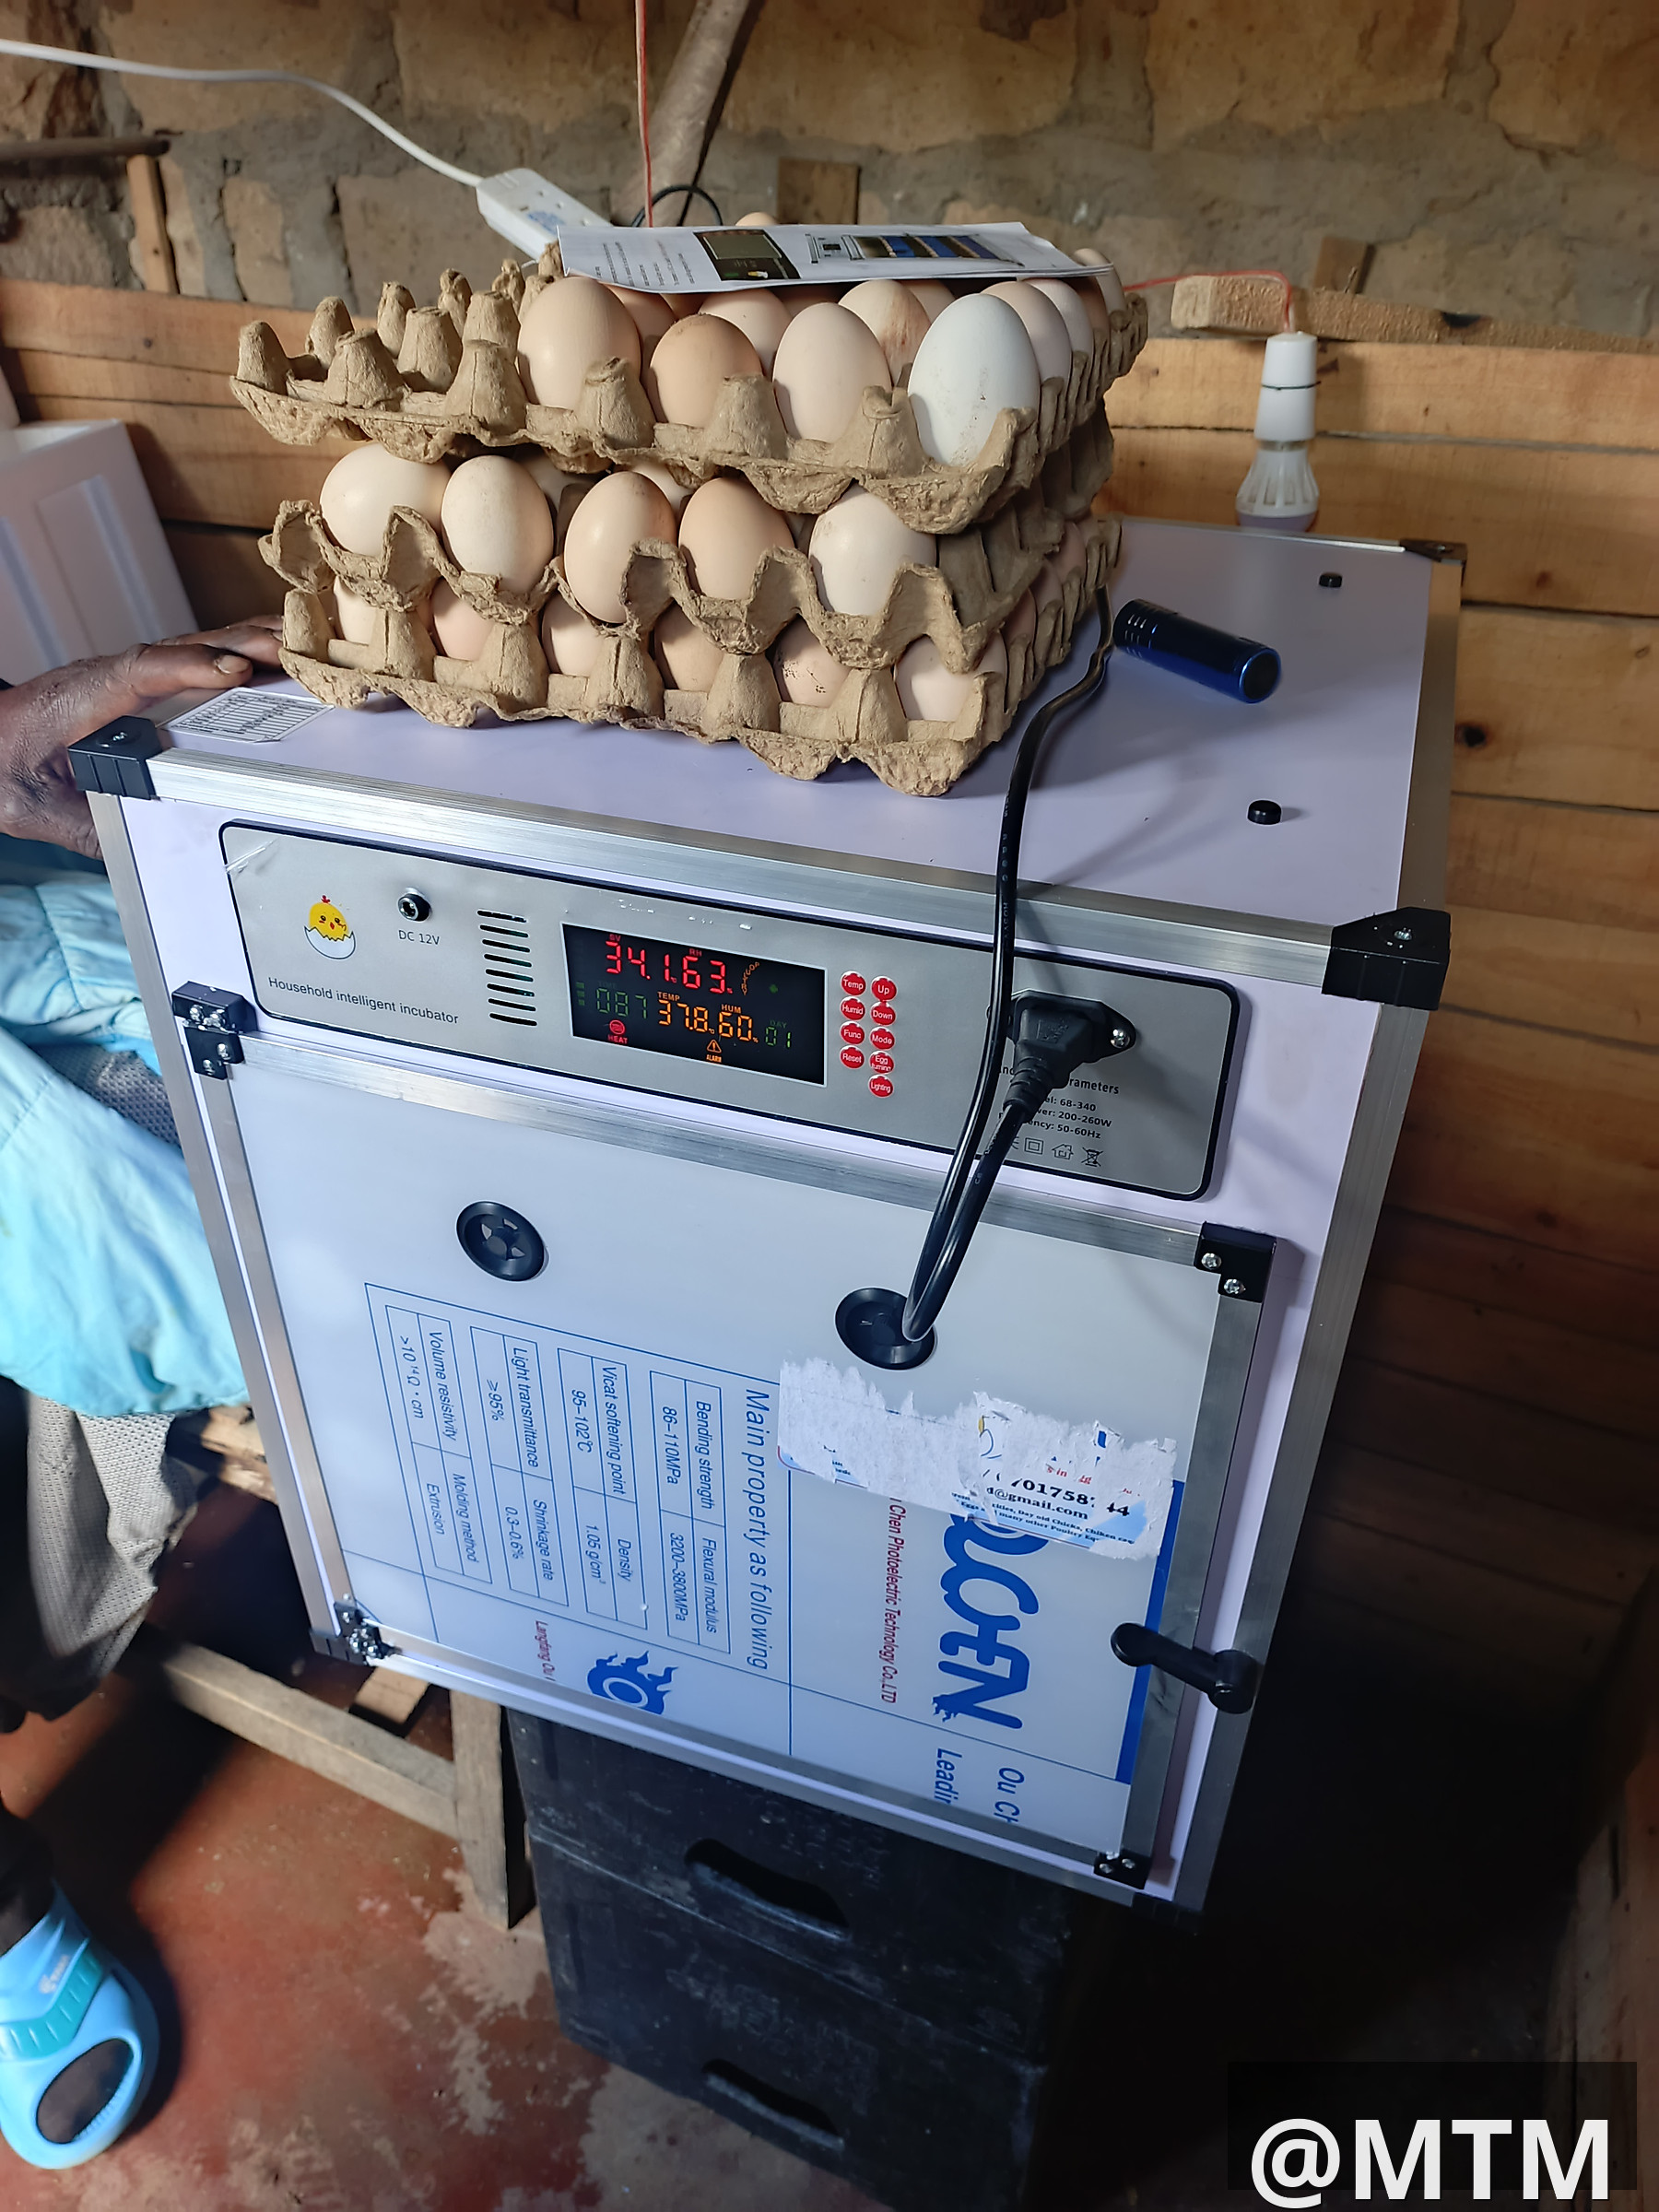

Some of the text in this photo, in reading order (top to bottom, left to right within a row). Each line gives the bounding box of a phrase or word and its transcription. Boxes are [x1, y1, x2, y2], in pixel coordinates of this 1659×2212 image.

[398, 929, 440, 945] DC 12V
[688, 947, 702, 958] RH
[842, 979, 864, 991] Temp
[877, 984, 890, 995] Up
[268, 977, 459, 1024] Household intelligent incubator
[596, 987, 647, 1019] 087
[657, 991, 680, 1002] TEMP
[721, 1004, 742, 1015] HUM
[841, 1004, 864, 1015] Humid
[872, 1009, 893, 1021] Down
[770, 1019, 787, 1029] DAY
[607, 1033, 629, 1044] HEAT
[765, 1026, 791, 1048] 01
[843, 1029, 862, 1040] Func
[871, 1034, 893, 1045] Mode
[706, 1053, 723, 1064] ALARM
[842, 1053, 862, 1064] Reset
[875, 1055, 888, 1065] Egg
[870, 1081, 891, 1094] Lighting
[1069, 1077, 1120, 1095] rameters
[1060, 1098, 1097, 1112] 68-340
[1058, 1110, 1112, 1128] 200-260W
[1056, 1124, 1101, 1139] 50-60Hz
[429, 1332, 458, 1441] Volume resistivity
[411, 1399, 424, 1418] cm
[511, 1347, 539, 1468] Light transmittance
[602, 1366, 627, 1495] Vicat softening point
[694, 1400, 715, 1510] Bending strength
[426, 1483, 445, 1535] Extrusion
[453, 1473, 480, 1564] Molding method
[888, 1503, 907, 1534] Chen
[585, 1524, 601, 1549] 1.05
[741, 1389, 772, 1670] Main property as following
[533, 1499, 555, 1581] Shrinkage rate
[618, 1538, 633, 1583] Density
[885, 1535, 905, 1606] Photoelectric
[701, 1537, 719, 1634] Flexural modulus
[535, 1620, 552, 1662] Langfang
[878, 1607, 901, 1665] Technology
[542, 1662, 556, 1677] Ou
[997, 1767, 1025, 1794] Ou
